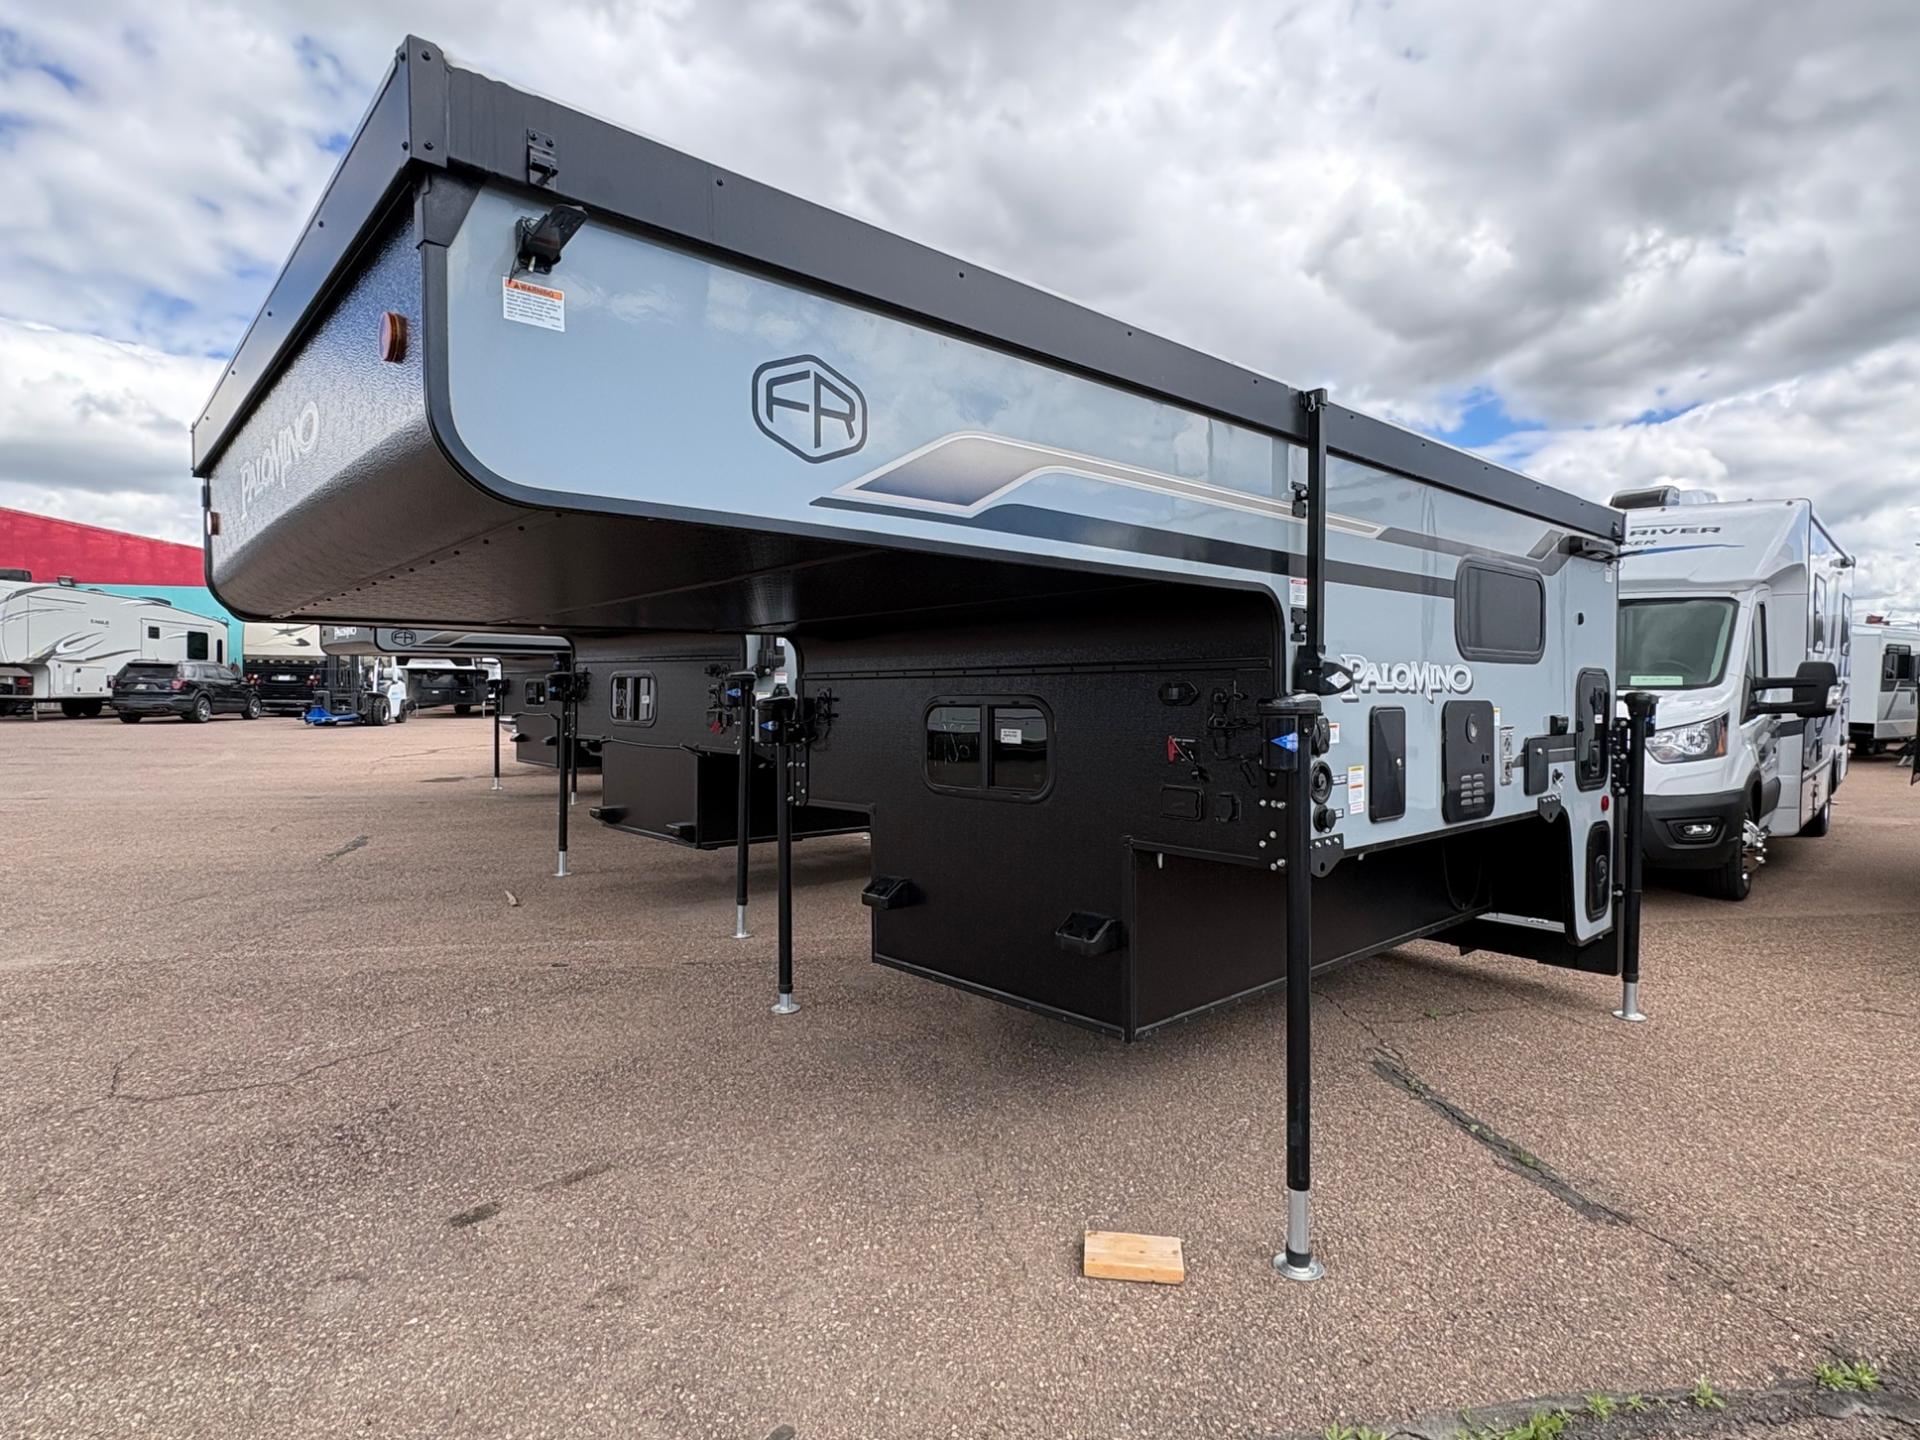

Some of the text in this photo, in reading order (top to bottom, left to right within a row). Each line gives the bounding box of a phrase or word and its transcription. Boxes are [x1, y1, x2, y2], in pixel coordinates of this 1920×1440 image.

[765, 369, 856, 449] FR
[240, 401, 319, 520] PALOMINO
[1629, 527, 1721, 536] RIVER
[1340, 653, 1474, 704] PALOMINO
